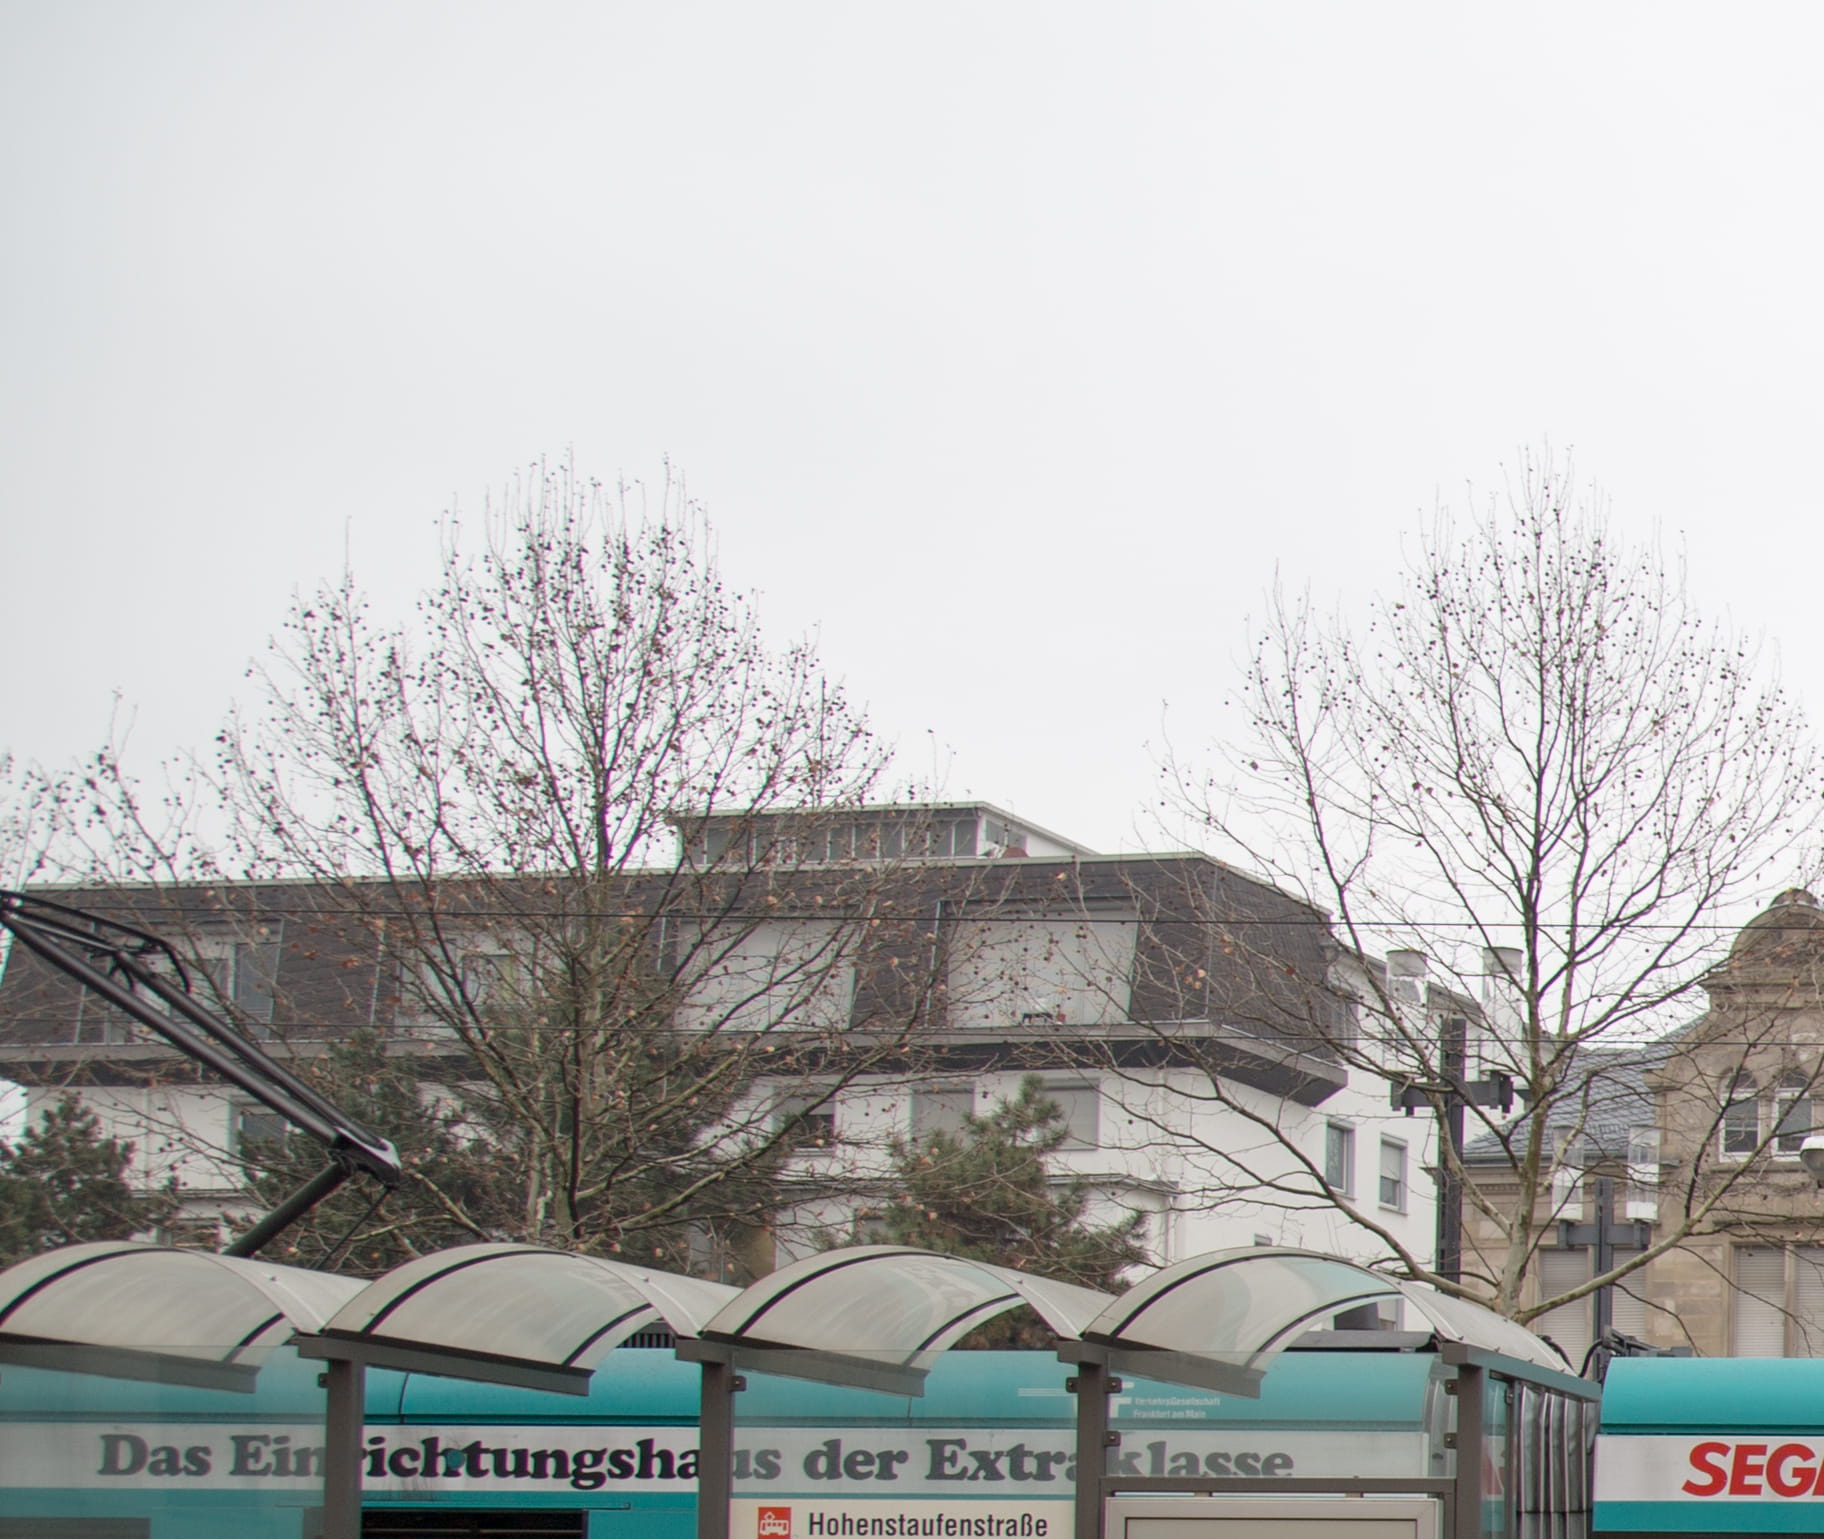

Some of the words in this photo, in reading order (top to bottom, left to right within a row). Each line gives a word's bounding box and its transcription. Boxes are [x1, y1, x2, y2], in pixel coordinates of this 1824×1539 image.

[97, 1434, 212, 1476] Das
[229, 1434, 781, 1490] Einichtungshaus
[803, 1438, 908, 1482] der
[808, 1512, 1048, 1538] Hohenstaufenstraße
